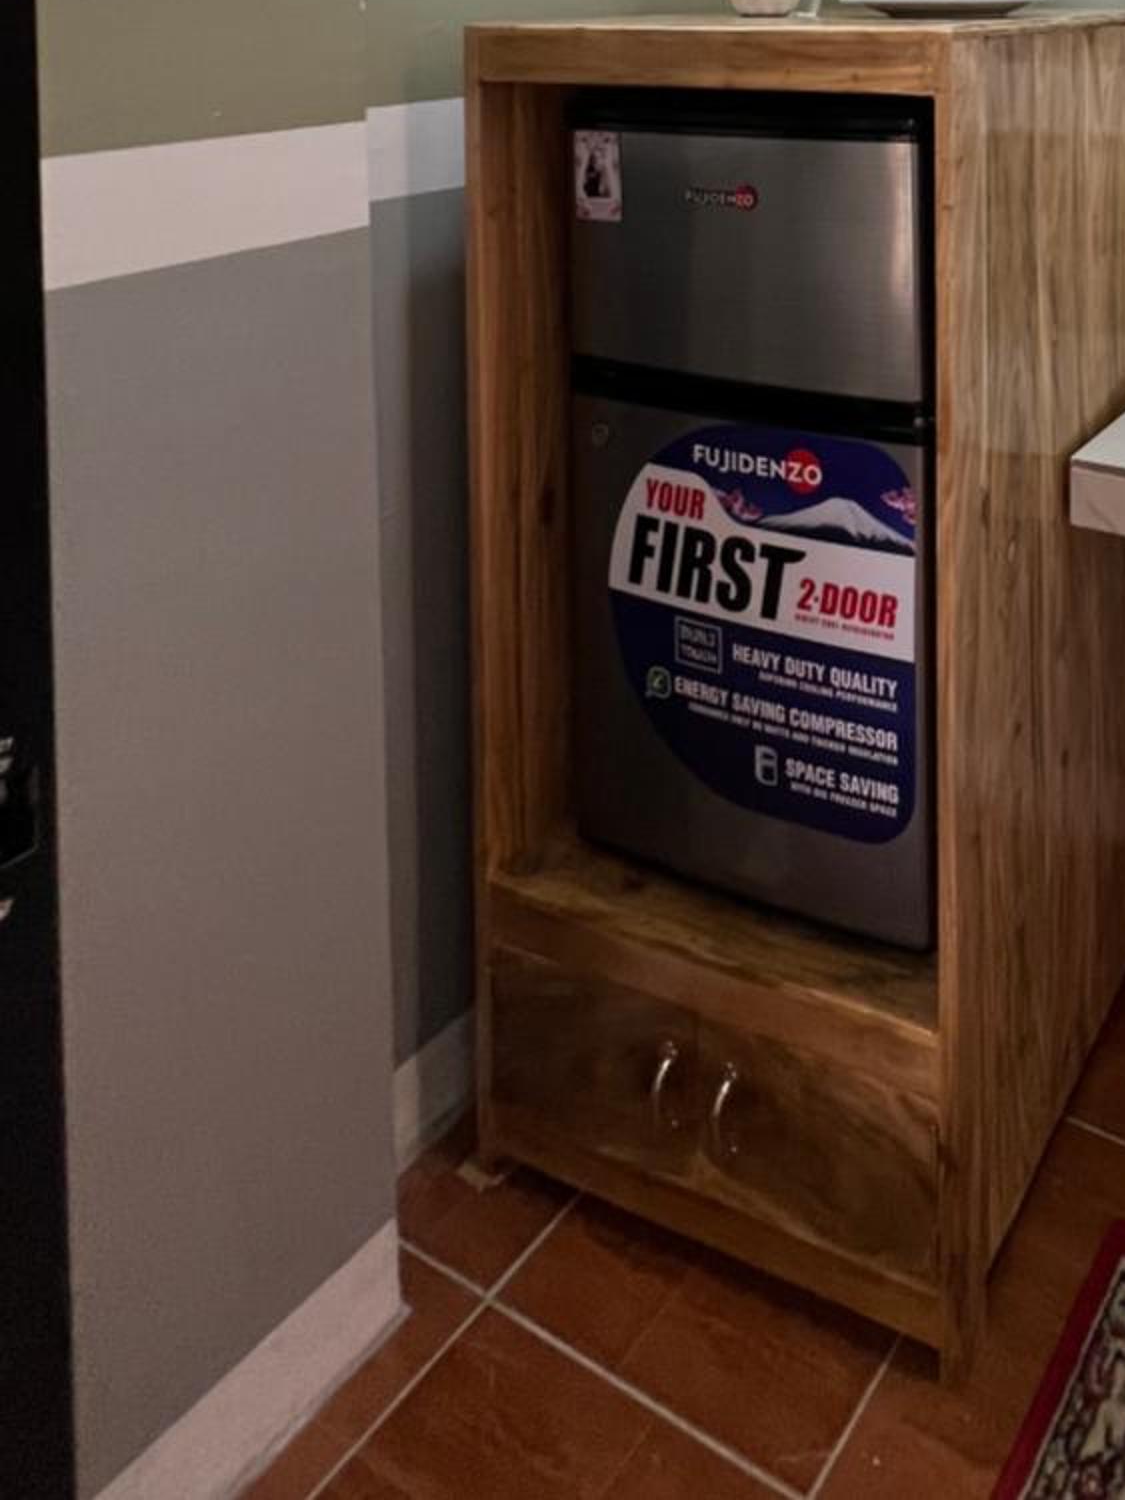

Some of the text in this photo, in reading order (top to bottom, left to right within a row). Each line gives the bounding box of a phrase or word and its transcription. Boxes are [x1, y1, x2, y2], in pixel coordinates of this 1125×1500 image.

[693, 444, 822, 484] FUJIDENZO
[646, 478, 705, 520] YOUR
[629, 513, 806, 620] FIRST
[732, 643, 781, 672] HEAVY
[785, 655, 826, 684] DUTY
[829, 666, 898, 698] QUALITY
[674, 675, 729, 708] ENERGY
[731, 691, 786, 724] SAVING
[789, 707, 898, 751] COMPRESSOR
[785, 757, 835, 790] SPACE
[839, 772, 899, 805] SAVING
